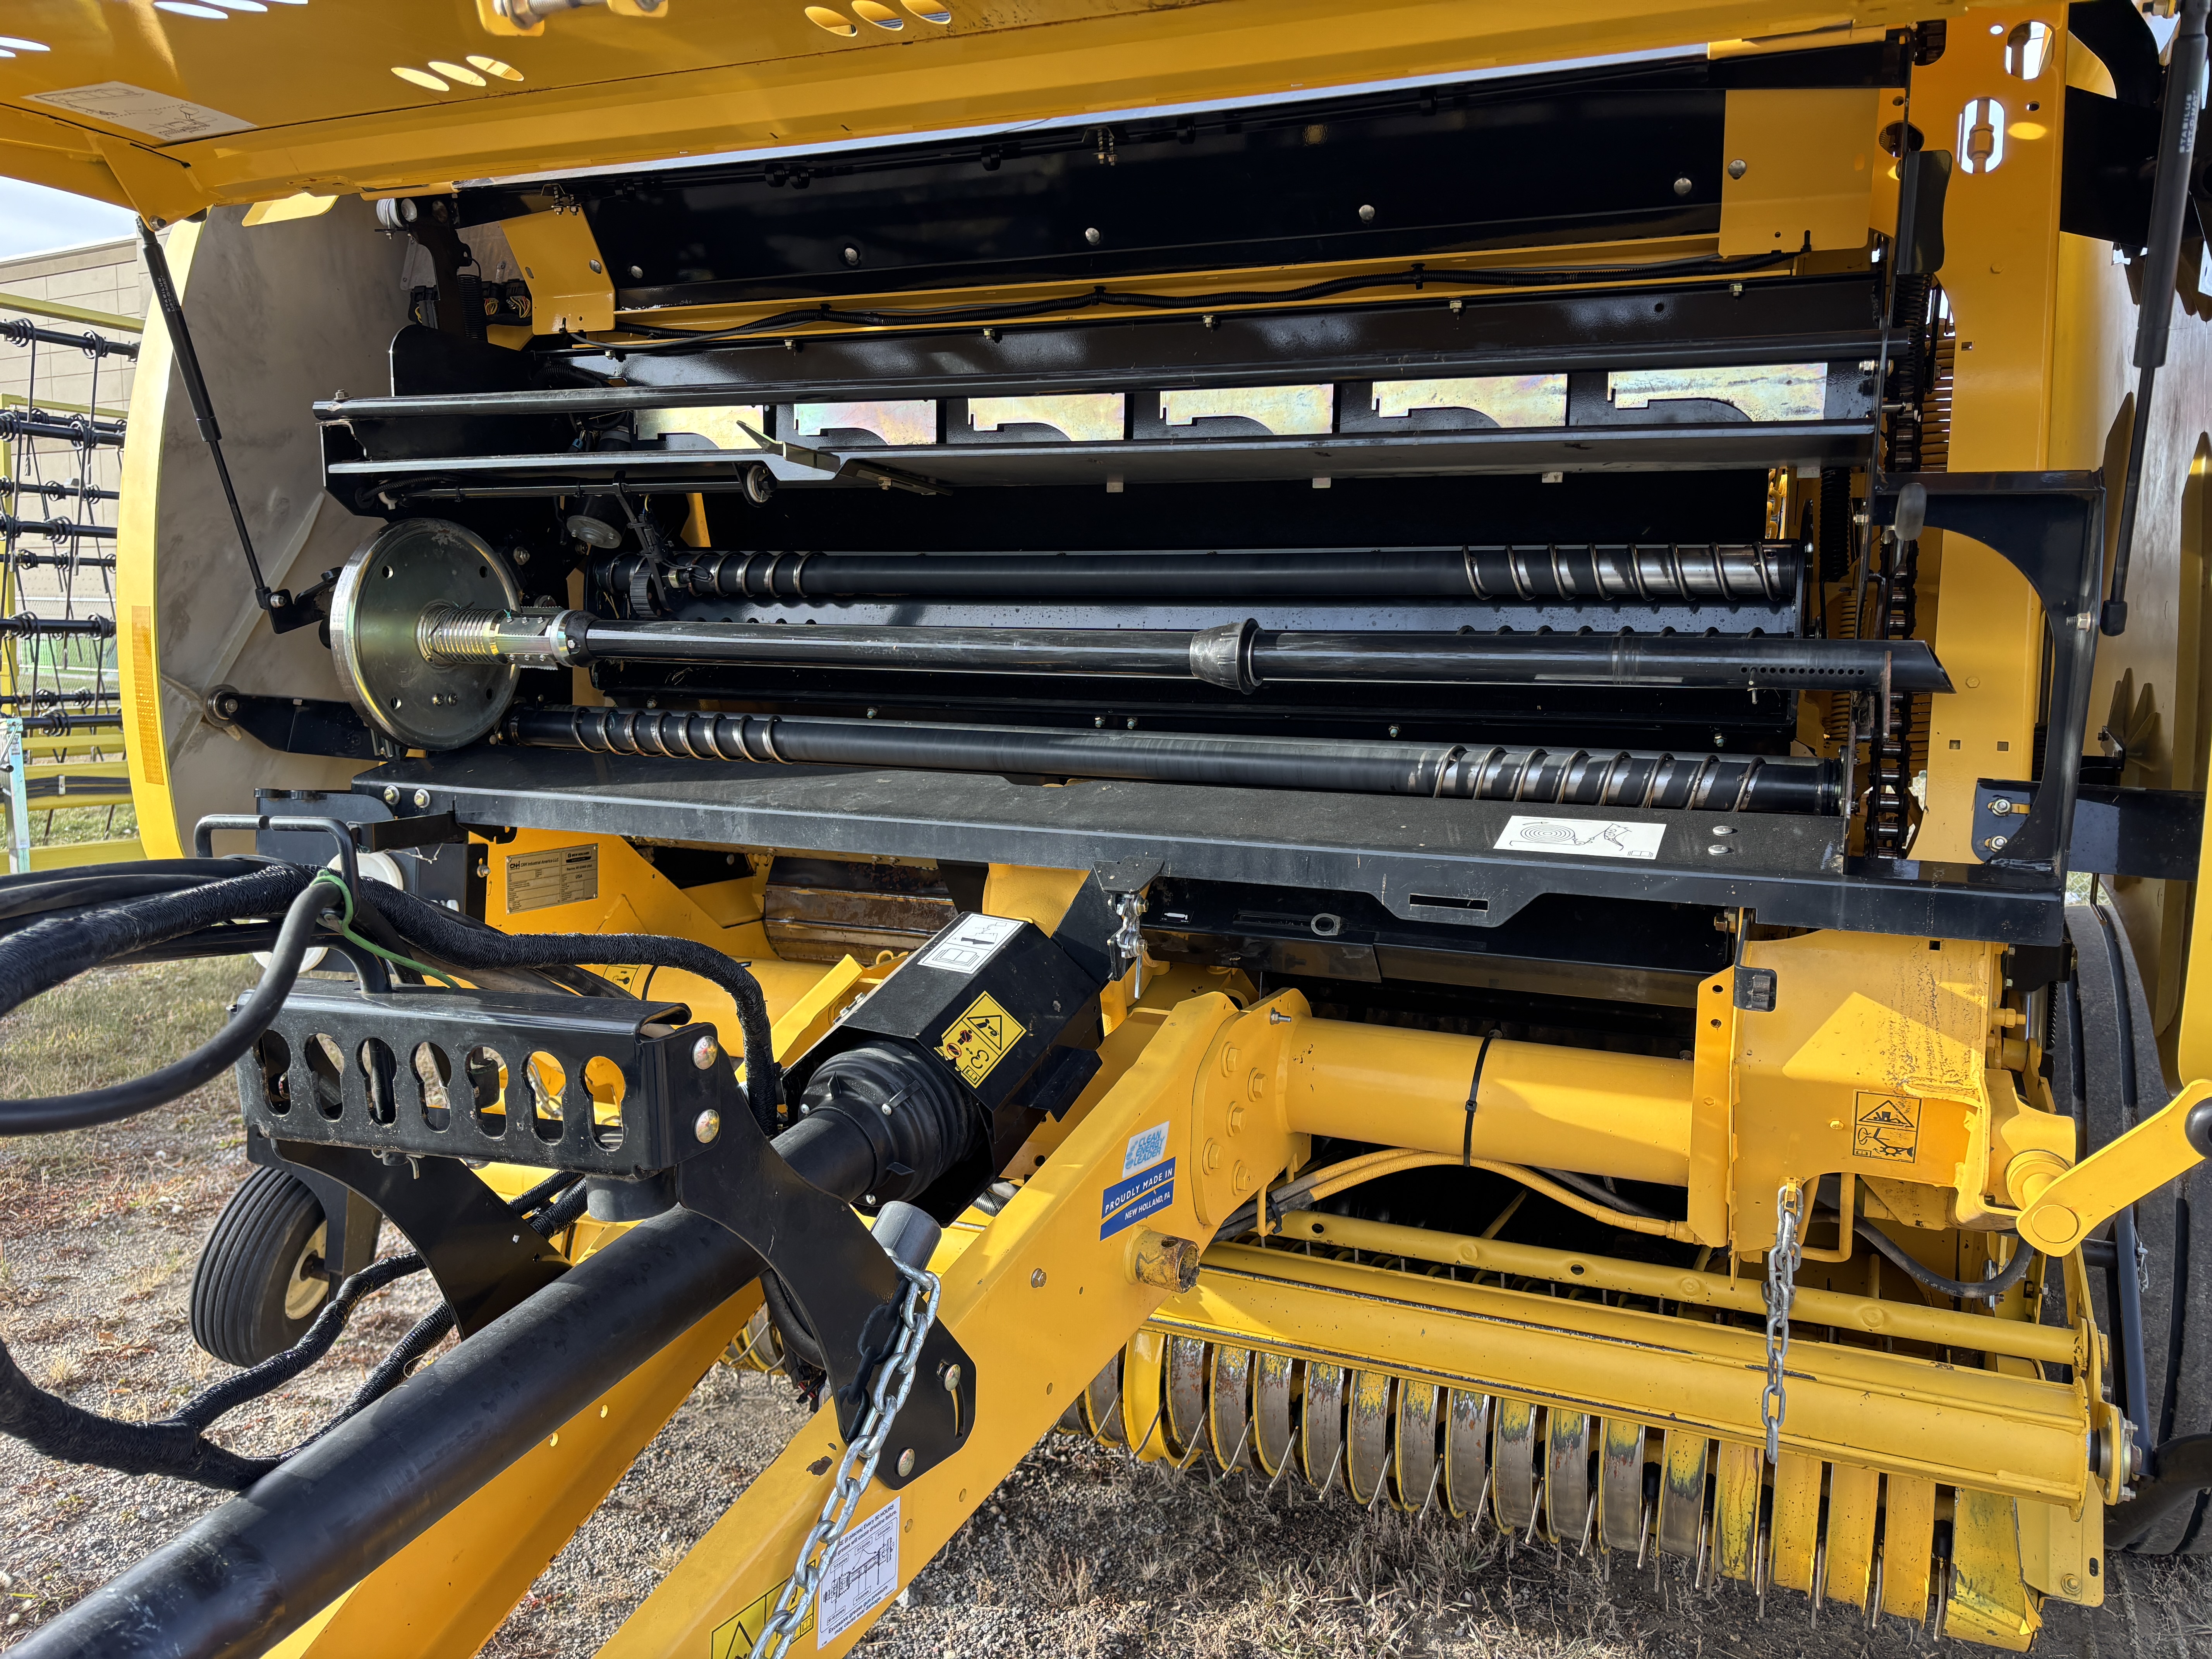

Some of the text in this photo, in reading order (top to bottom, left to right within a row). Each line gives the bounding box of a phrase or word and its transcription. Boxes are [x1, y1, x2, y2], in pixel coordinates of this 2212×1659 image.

[1136, 1136, 1164, 1157] ENERGY
[1139, 1130, 1161, 1146] CLEAN
[1133, 1147, 1161, 1166] LEADER
[1105, 1168, 1173, 1214] PROUDLY MADE IN
[1125, 1191, 1171, 1220] NEW HOLLAND, PA
[849, 1527, 864, 1540] places)
[864, 1519, 874, 1529] Every
[880, 1504, 894, 1517] HOURS
[837, 1543, 850, 1556] grease
[858, 1530, 869, 1540] cause
[870, 1518, 884, 1532] driveline
[828, 1616, 848, 1634] Excessive
[849, 1605, 863, 1619] grease
[871, 1585, 888, 1601] pressure
[835, 1625, 843, 1635] may
[844, 1616, 856, 1627] cause
[857, 1609, 865, 1618] seal
